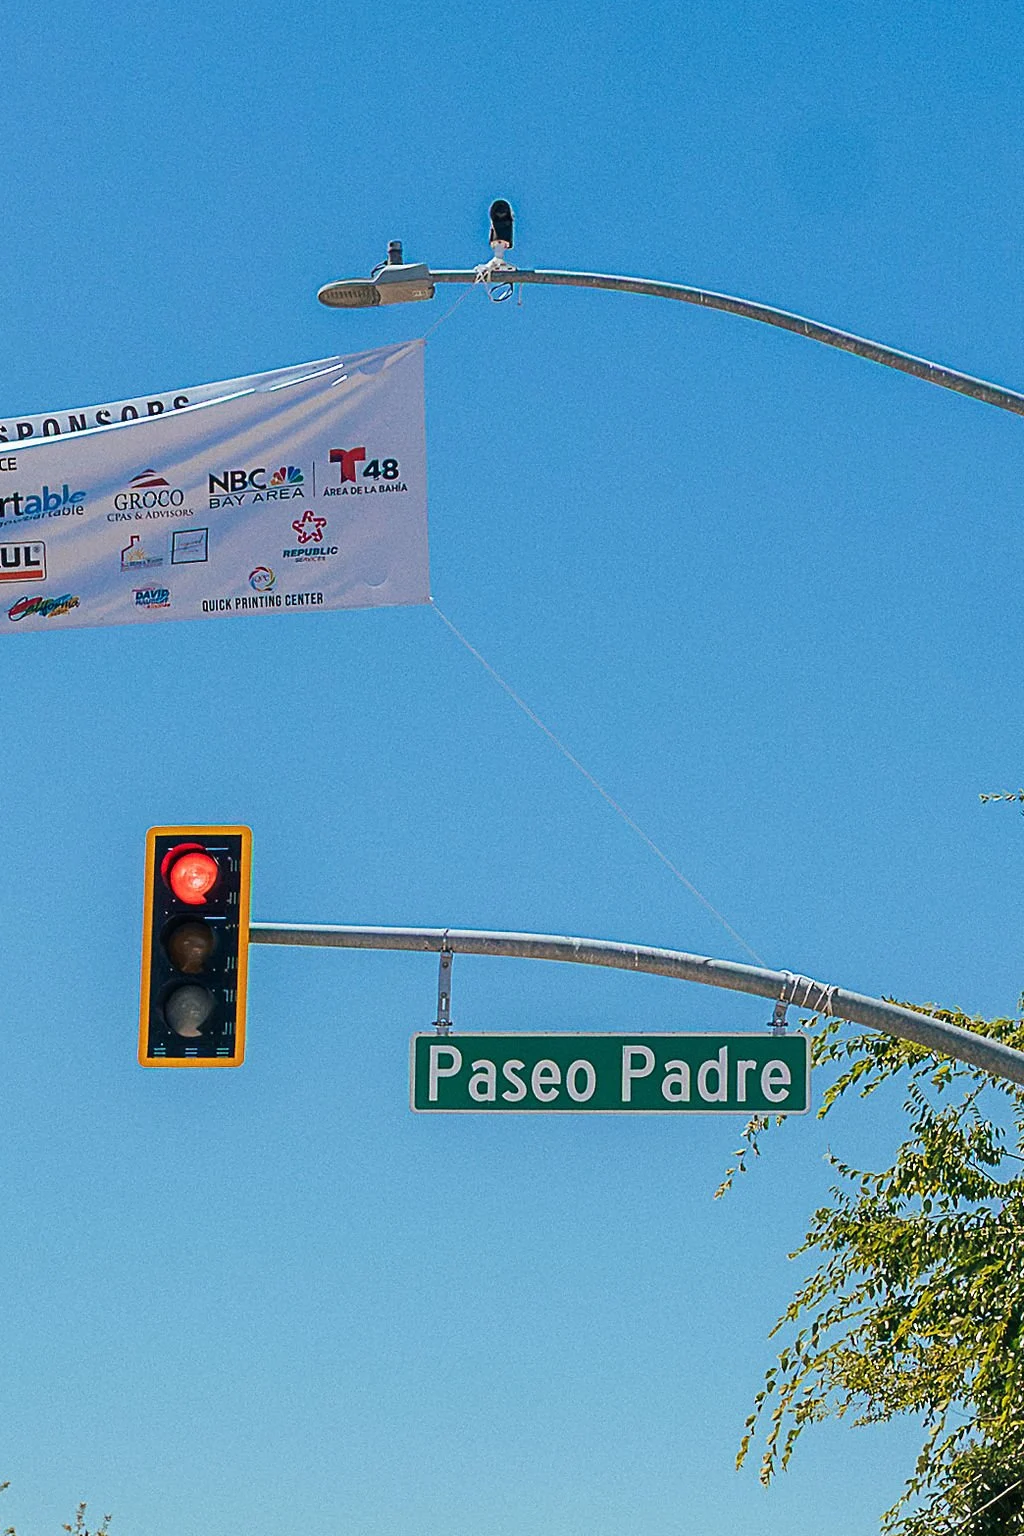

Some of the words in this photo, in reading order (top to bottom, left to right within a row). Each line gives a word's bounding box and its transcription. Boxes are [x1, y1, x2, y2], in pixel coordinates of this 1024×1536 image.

[362, 458, 400, 481] 48
[208, 468, 267, 494] NBC
[323, 486, 349, 497] ÁREA
[351, 486, 363, 496] DE
[378, 481, 408, 493] BAHÍA
[114, 489, 184, 511] GROCO
[209, 494, 244, 510] BAY
[252, 487, 305, 504] AREA
[145, 508, 194, 520] ADVISORS
[283, 546, 338, 558] REPUBLIC
[202, 599, 232, 612] QUICK
[235, 594, 282, 610] PRINTING
[285, 592, 324, 607] CENTER
[428, 1044, 597, 1102] Paseo
[622, 1044, 792, 1102] Padre
